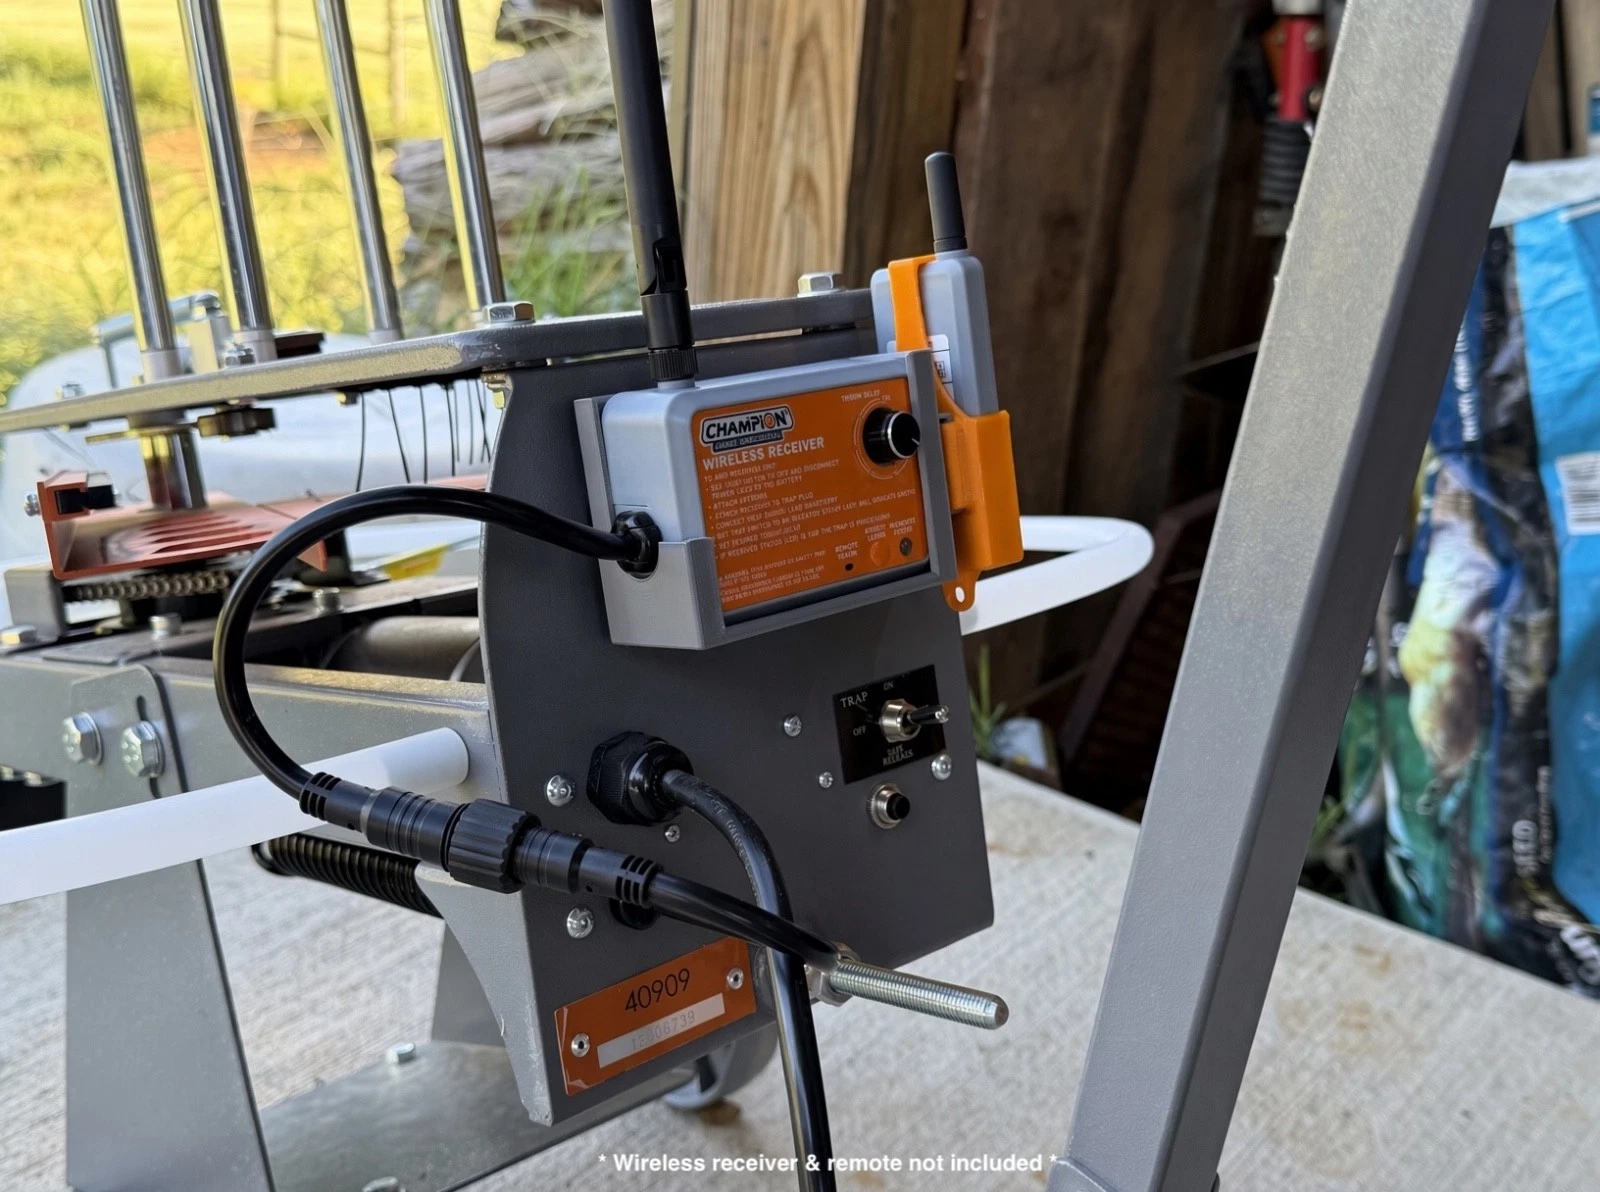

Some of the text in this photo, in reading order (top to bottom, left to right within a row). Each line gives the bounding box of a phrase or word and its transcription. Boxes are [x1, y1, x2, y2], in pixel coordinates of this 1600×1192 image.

[706, 410, 788, 439] CHAMPION
[703, 448, 764, 471] WIRELESS
[768, 436, 825, 459] RECEIVER
[840, 691, 869, 708] TRAP
[624, 967, 690, 1012] 40909
